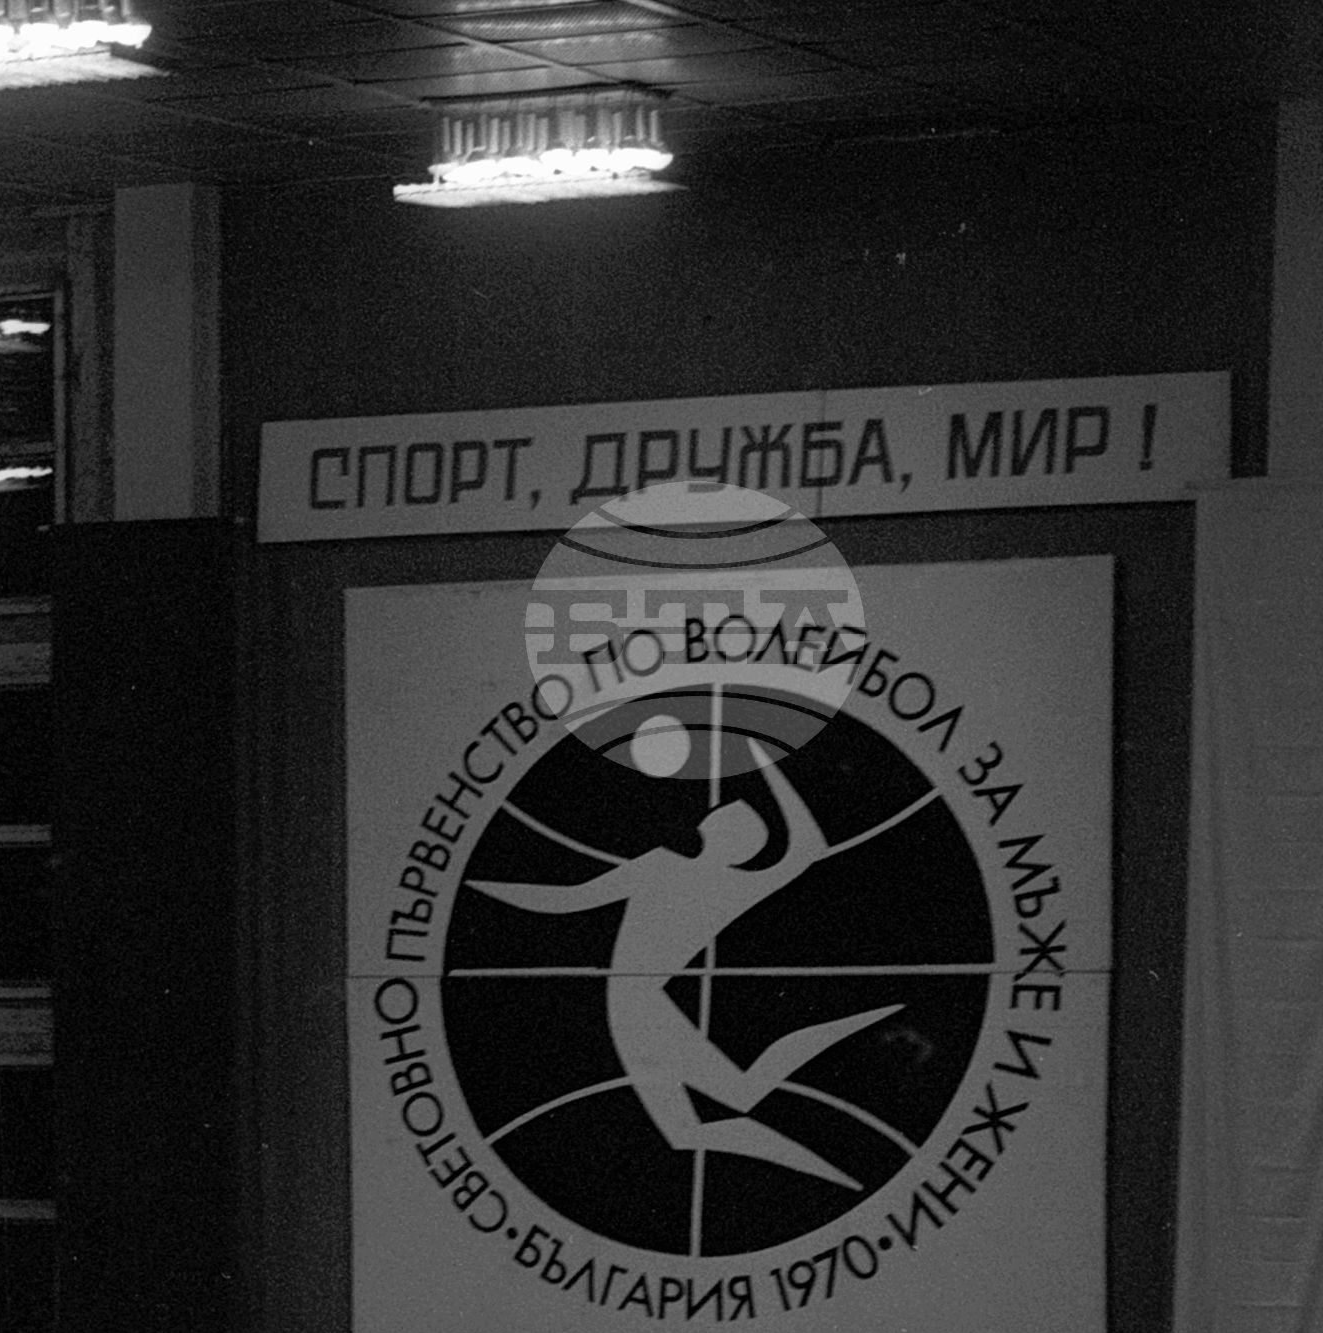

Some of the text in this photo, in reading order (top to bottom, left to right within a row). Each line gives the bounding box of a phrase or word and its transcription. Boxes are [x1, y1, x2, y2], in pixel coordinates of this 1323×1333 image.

[309, 436, 542, 510] СПОРТ,
[569, 417, 913, 506] ДРУЖБА,
[374, 614, 1068, 1252] СВЕТОВНО ПЪРВЕНСТВО ПО ВОЛЕЙБОЛ ЗА МЪЖЕ И ЖЕНИ
[513, 1224, 879, 1323] БЪЛГАРИЯ 1970
